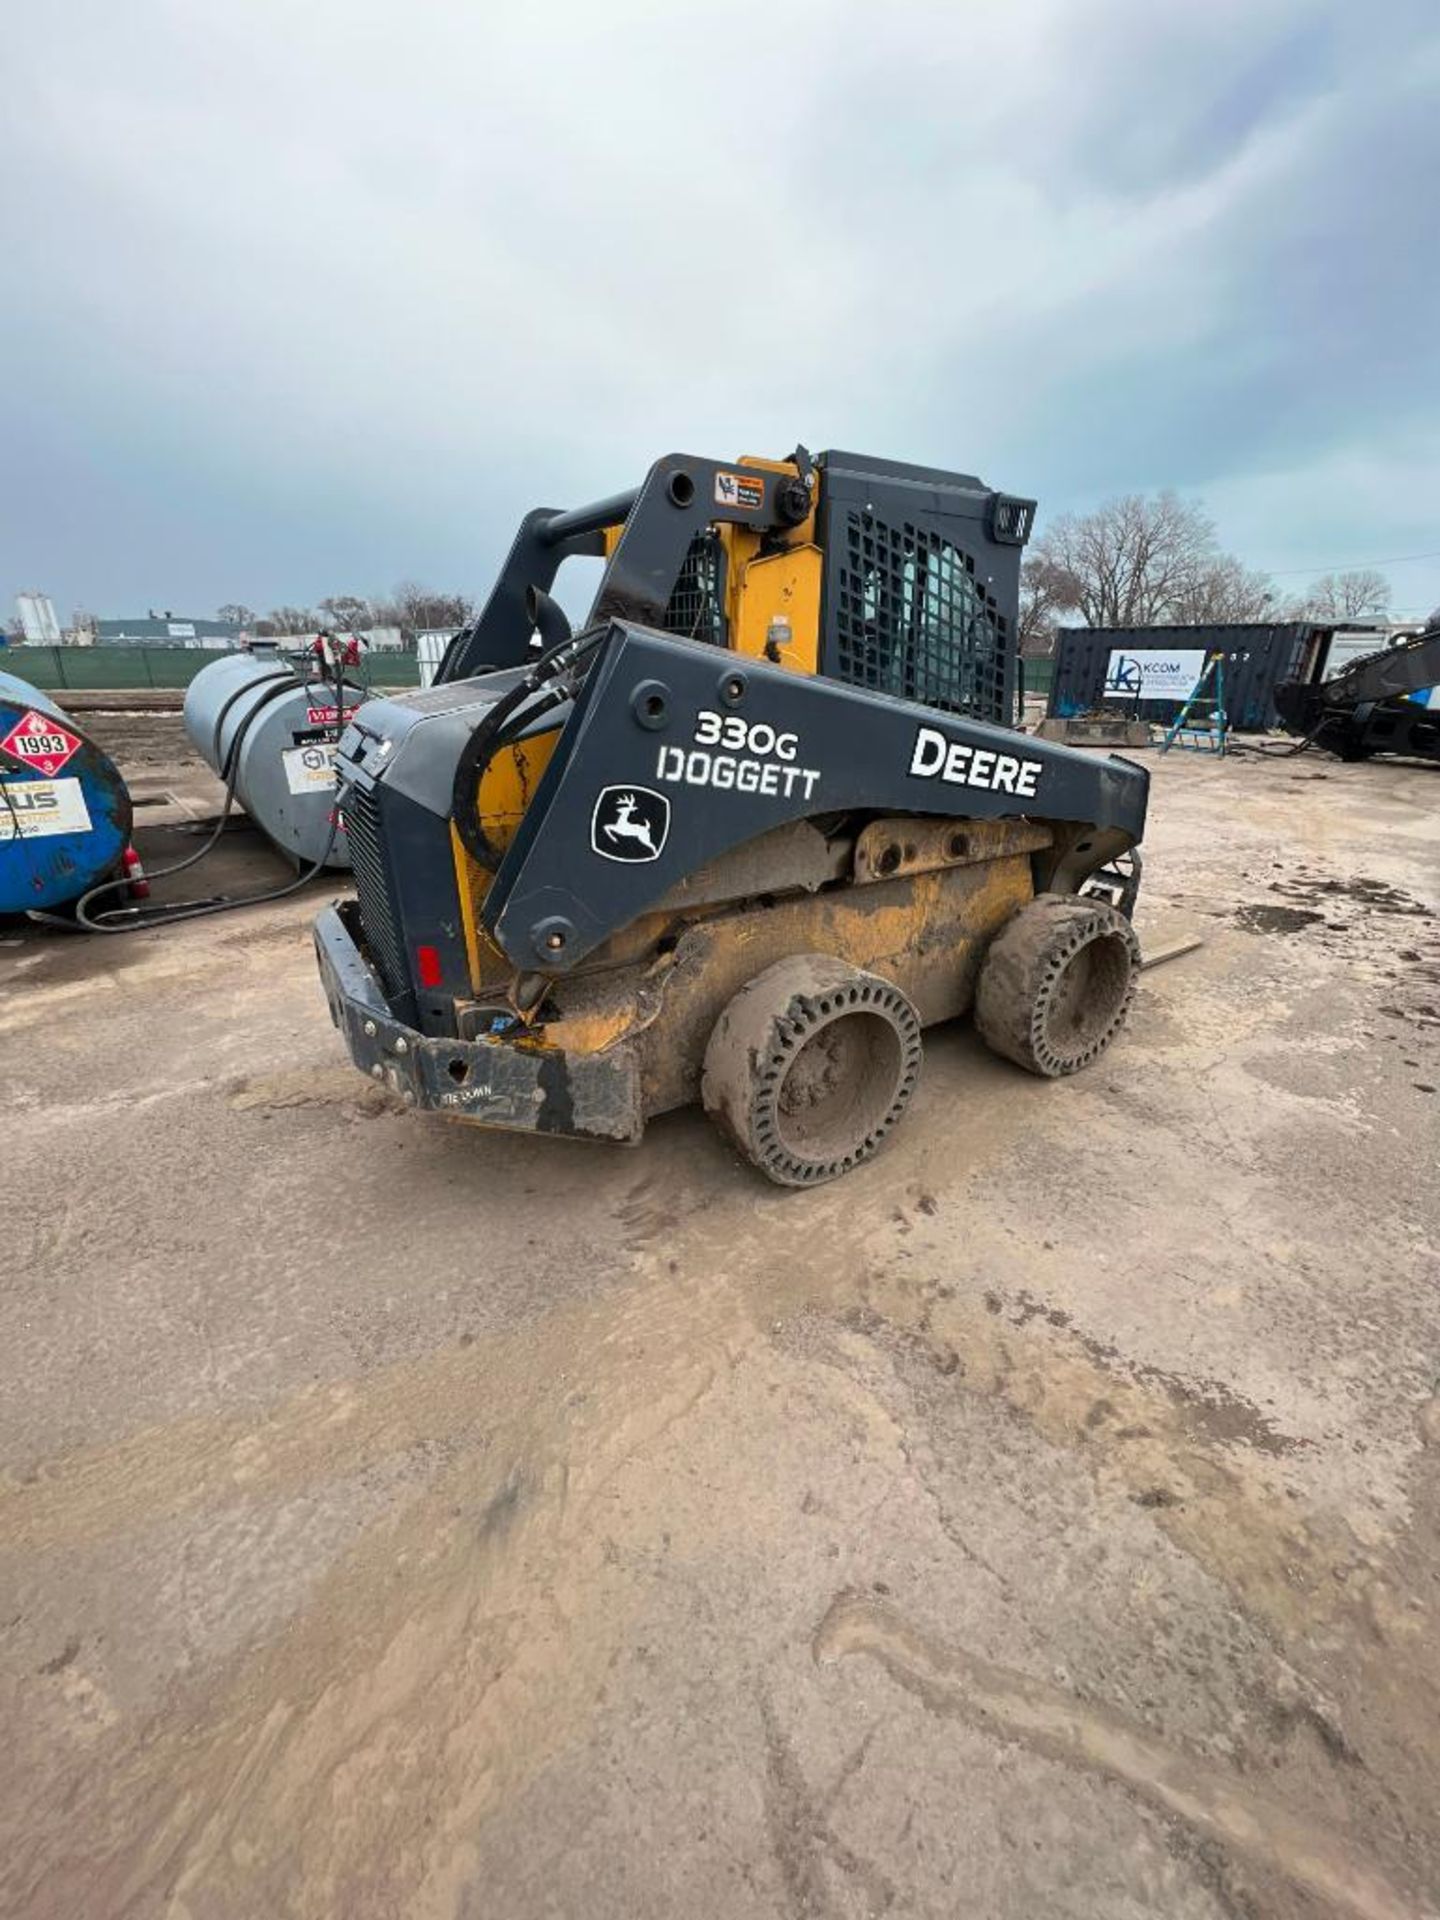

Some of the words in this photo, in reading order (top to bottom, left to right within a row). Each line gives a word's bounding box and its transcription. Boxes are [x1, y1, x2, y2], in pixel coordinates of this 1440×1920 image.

[1143, 661, 1181, 674] KCOM
[19, 735, 65, 754] 1993
[694, 711, 799, 760] 330G
[42, 759, 54, 771] 3
[656, 746, 821, 800] DOGGETT
[910, 728, 1042, 797] DEERE
